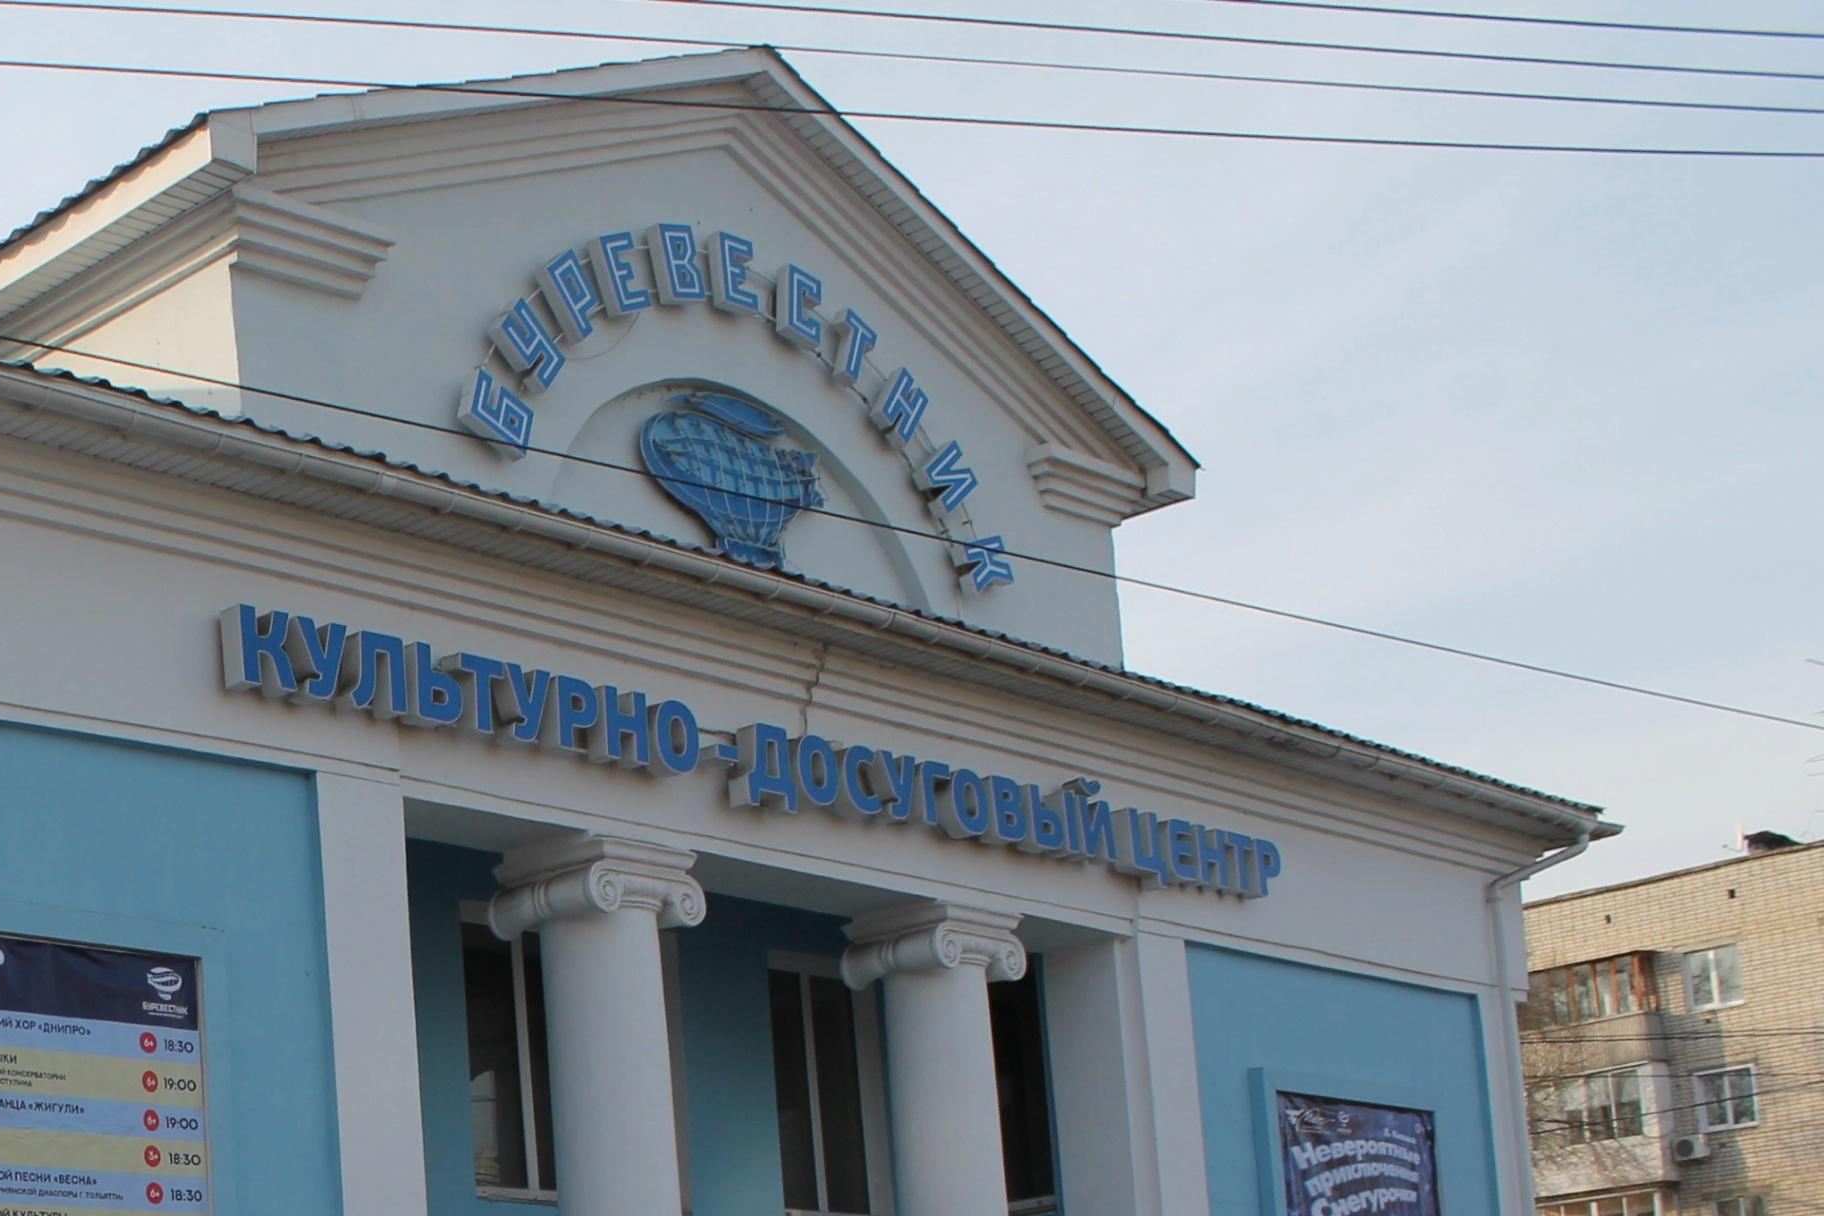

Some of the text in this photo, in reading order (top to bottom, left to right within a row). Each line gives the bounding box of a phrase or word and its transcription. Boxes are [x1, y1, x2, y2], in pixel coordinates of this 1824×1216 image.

[458, 223, 1014, 594] БУРЕВЕСТНИК
[1116, 806, 1281, 898] ЦЕНТР
[16, 1020, 36, 1029] ХОР
[38, 1022, 91, 1036] «ДНИПРО»
[143, 1037, 155, 1047] 6+
[164, 1038, 194, 1053] 18:30
[164, 1077, 196, 1091] 19:00
[28, 1102, 85, 1114] «ЖИГУЛИ»
[166, 1116, 198, 1130] 19:00
[168, 1152, 201, 1166] 18:30
[1291, 1139, 1421, 1169] Невероятные
[14, 1171, 51, 1183] ПЕСНИ
[53, 1174, 97, 1186] «ВЕСНА»
[1304, 1162, 1419, 1196] приключения
[150, 1188, 160, 1198] 6+
[170, 1188, 202, 1202] 18:30
